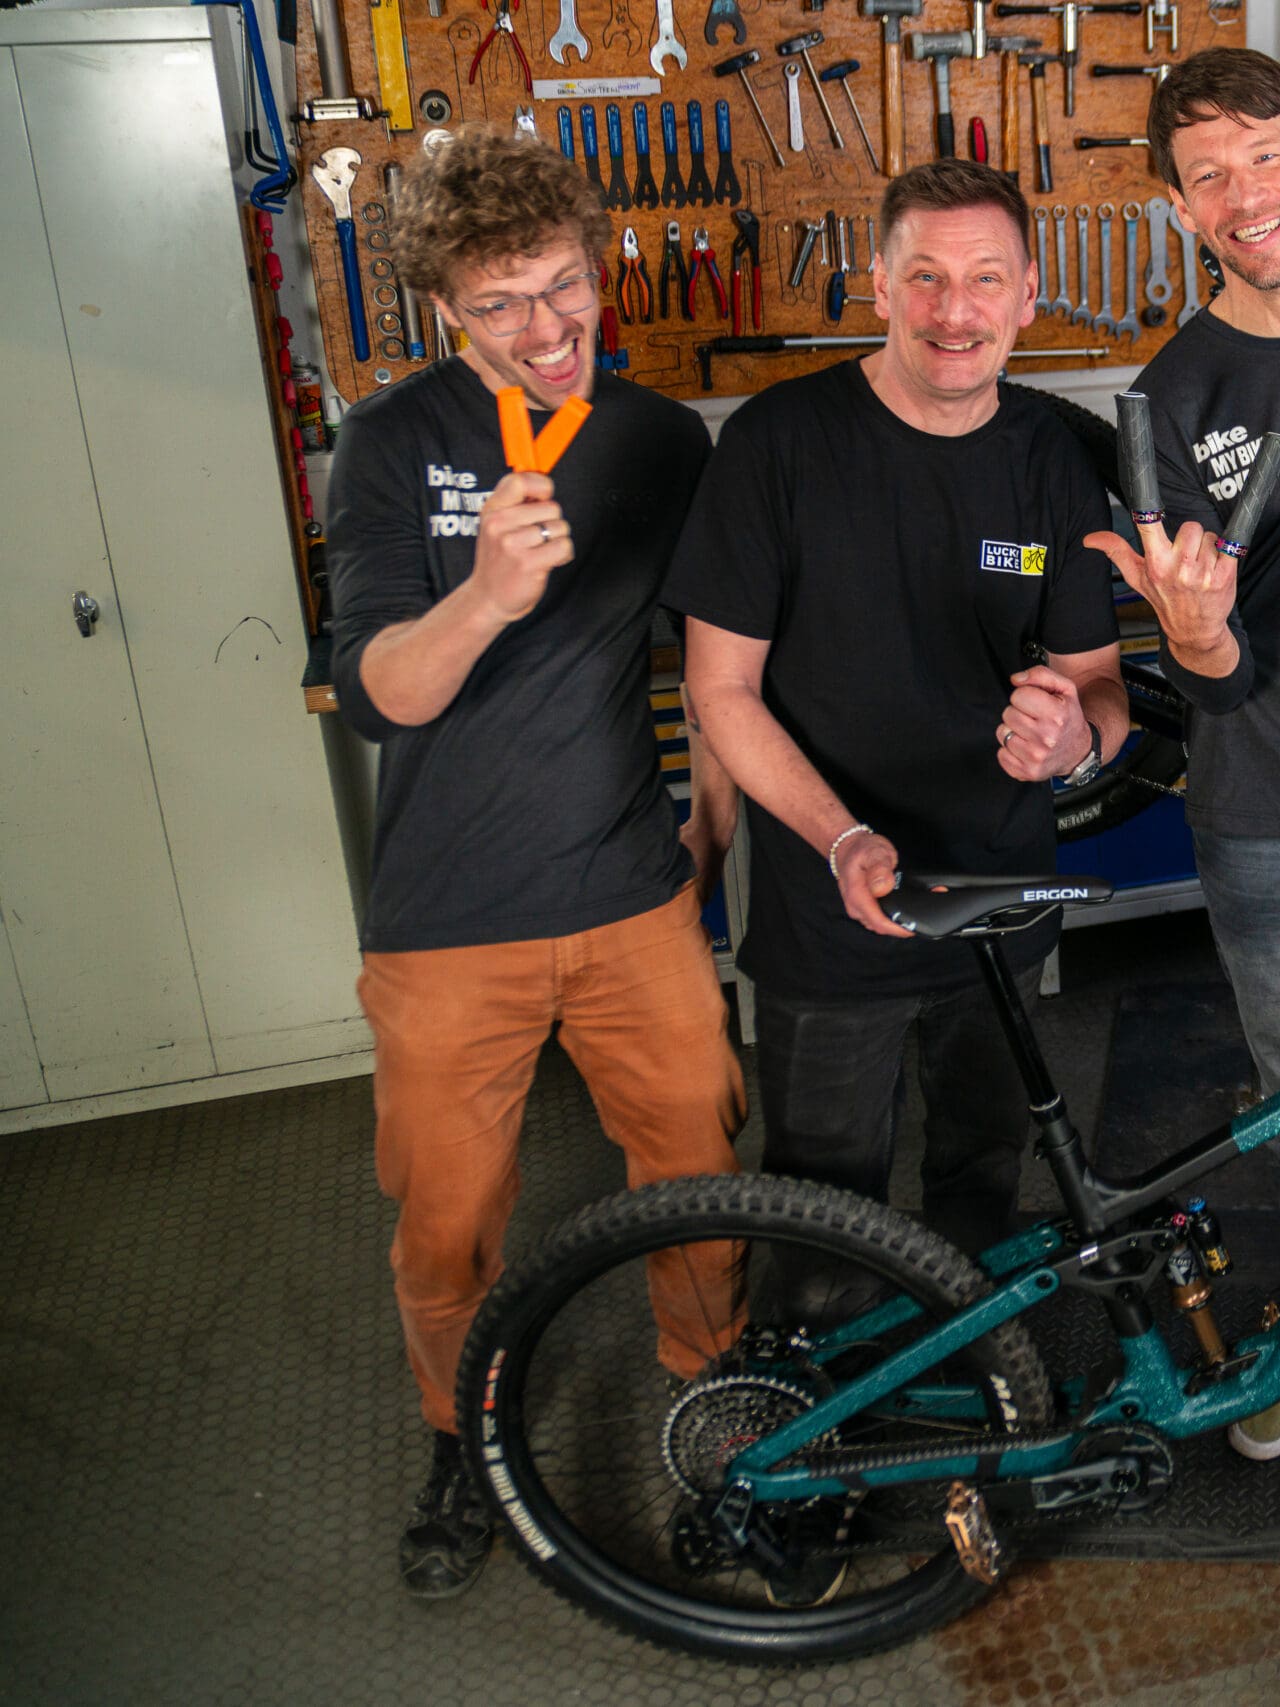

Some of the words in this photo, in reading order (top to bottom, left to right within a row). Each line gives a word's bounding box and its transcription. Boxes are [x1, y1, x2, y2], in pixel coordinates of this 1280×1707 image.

[1193, 425, 1248, 464] bike
[1207, 468, 1250, 501] TOU
[986, 554, 1020, 569] BIKE
[1023, 888, 1088, 902] ERGON
